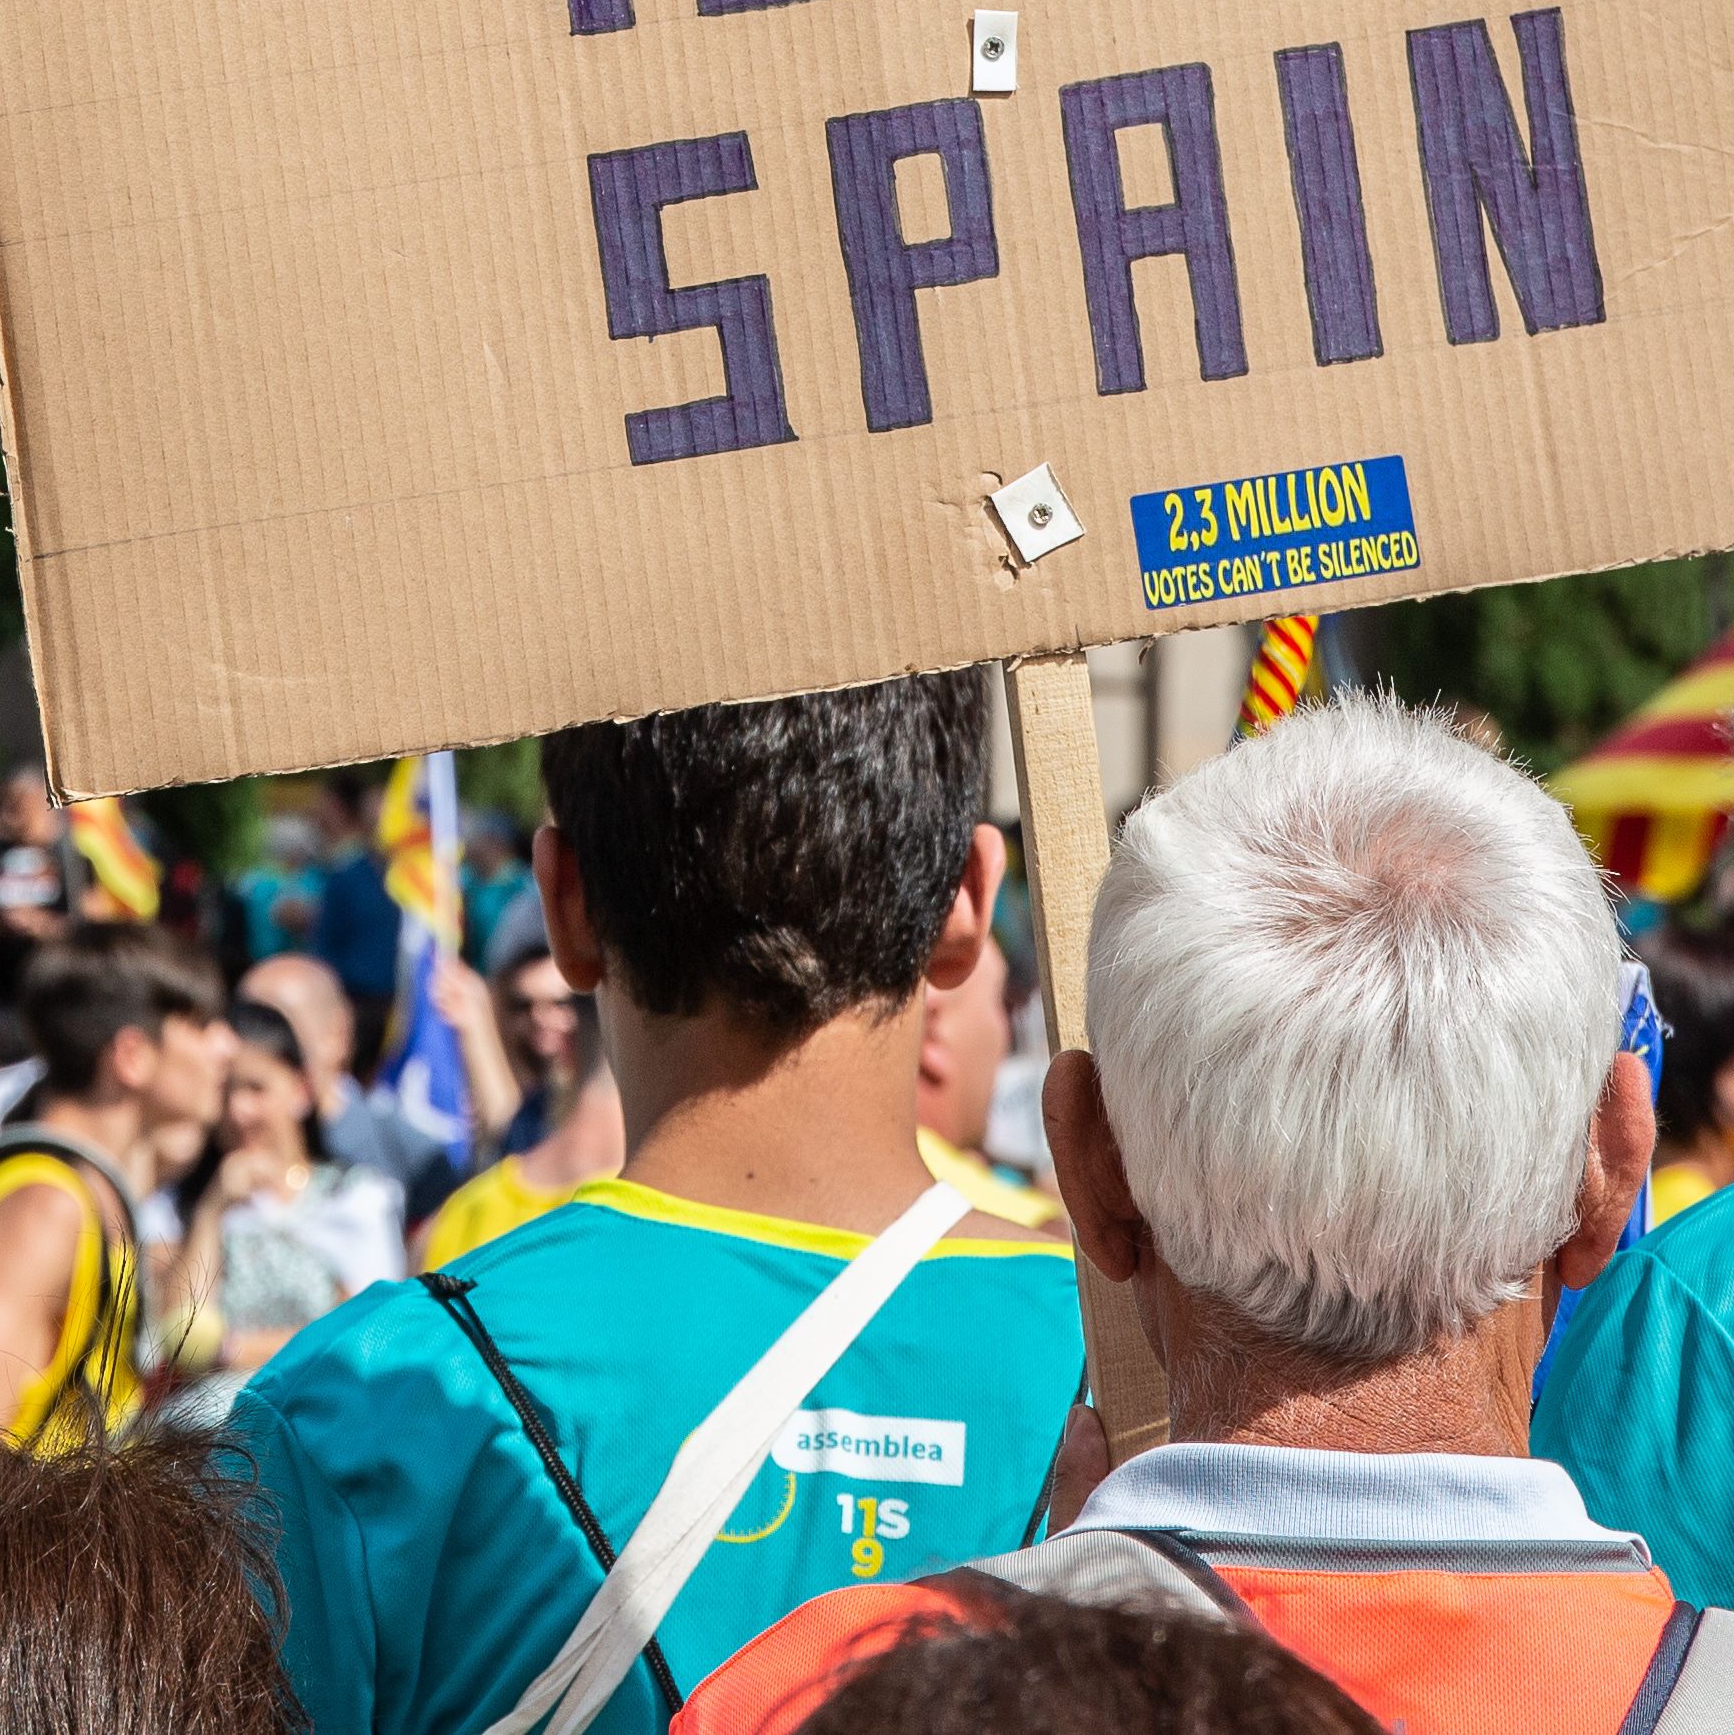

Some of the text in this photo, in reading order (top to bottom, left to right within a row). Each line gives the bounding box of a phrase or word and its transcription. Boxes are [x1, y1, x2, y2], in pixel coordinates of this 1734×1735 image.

[587, 6, 1607, 466] SPAIN
[1163, 462, 1372, 553] 2,3 MILLION
[1143, 530, 1419, 608] VOTES CAN'T BE SILENCED
[797, 1430, 943, 1462] assemblea
